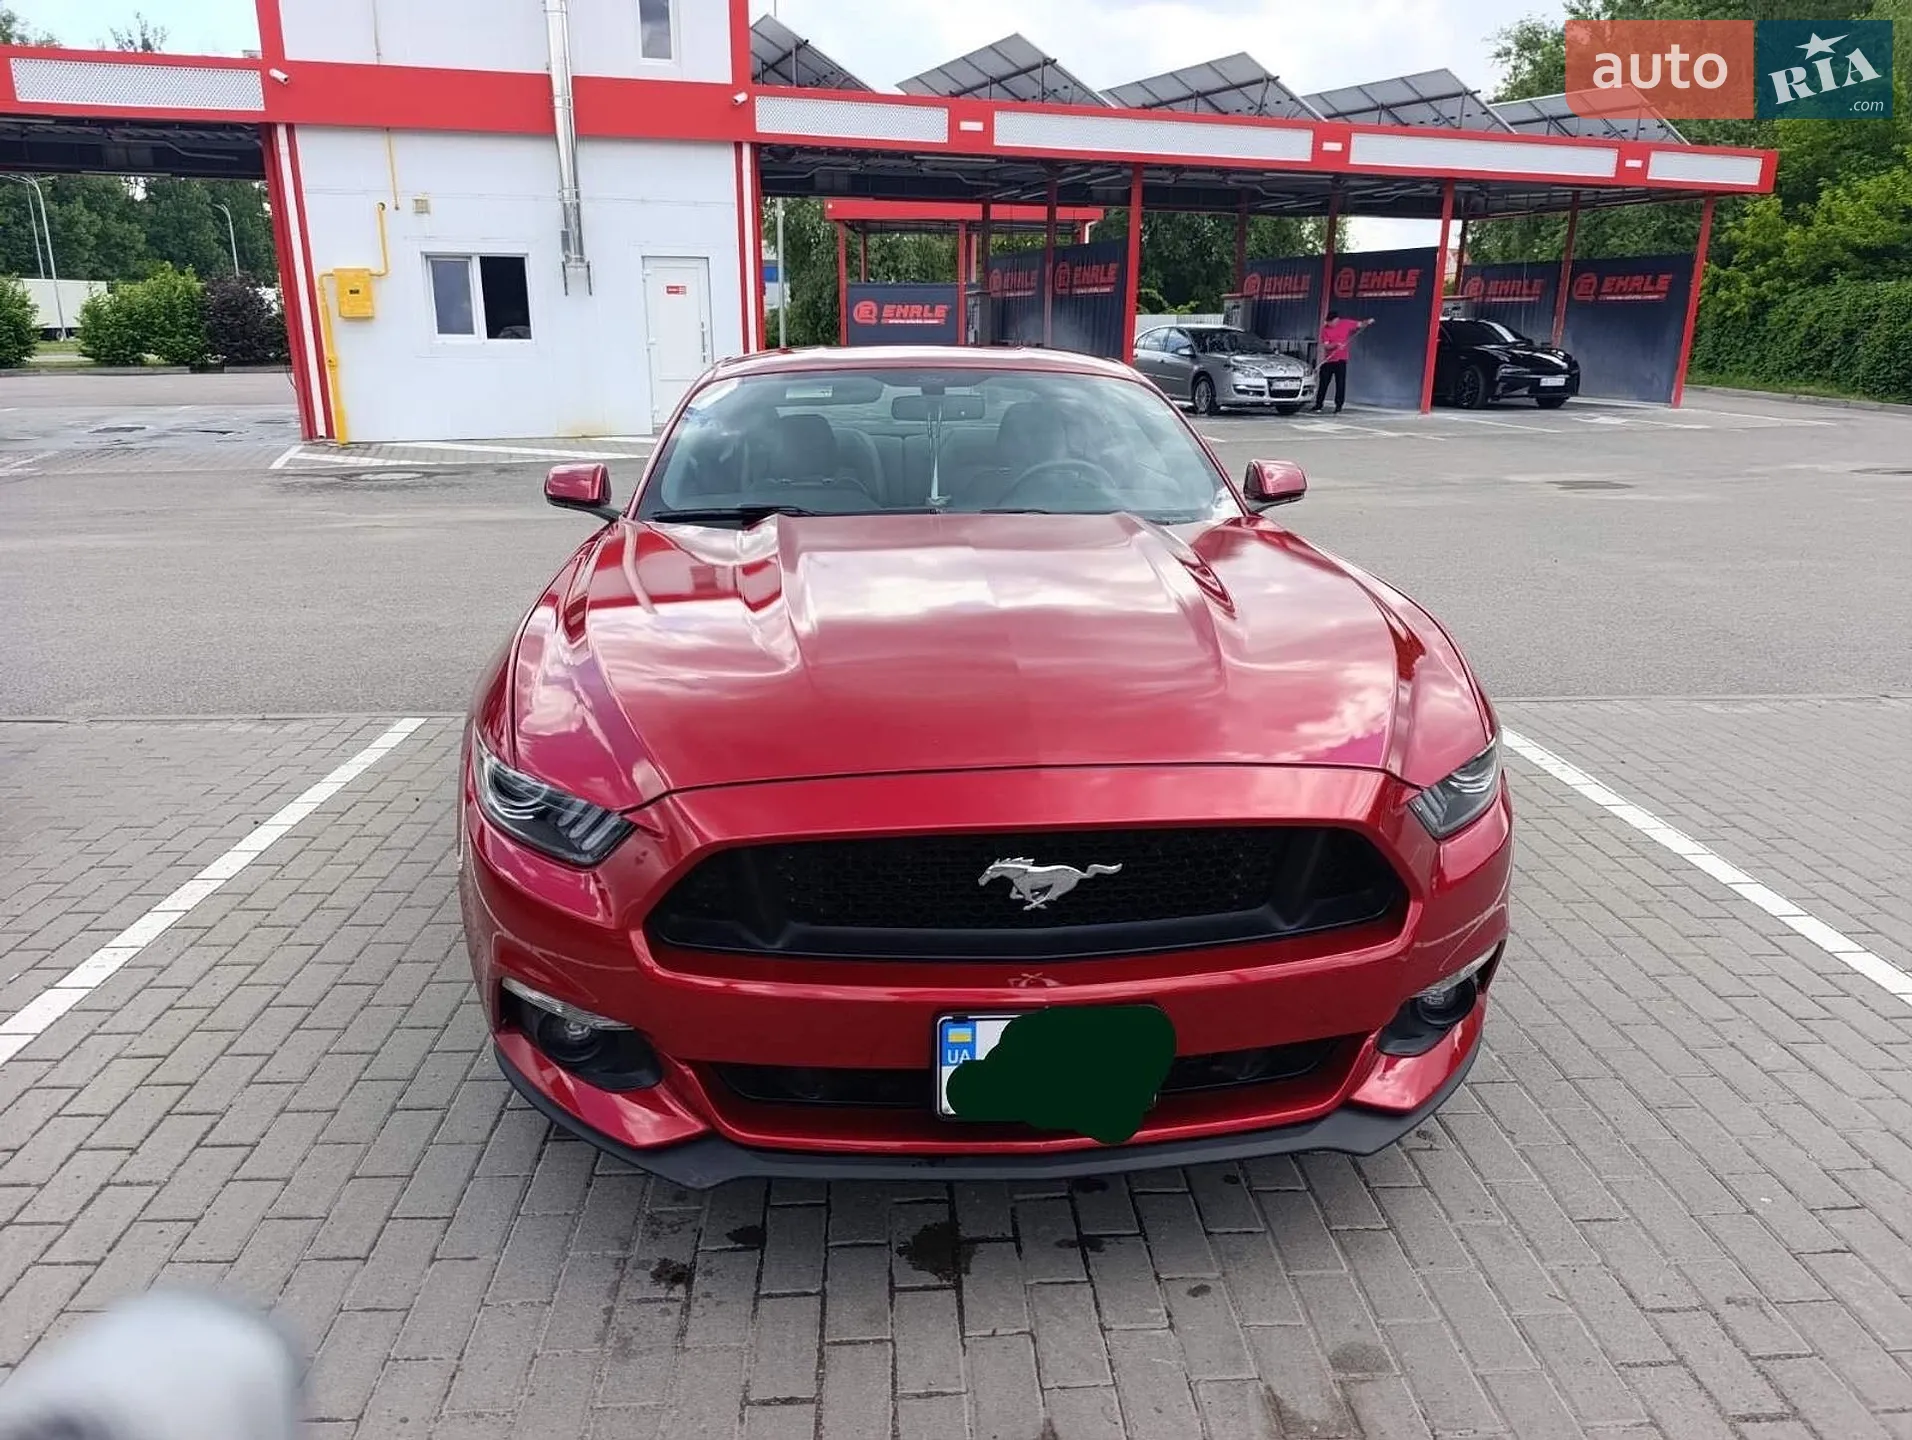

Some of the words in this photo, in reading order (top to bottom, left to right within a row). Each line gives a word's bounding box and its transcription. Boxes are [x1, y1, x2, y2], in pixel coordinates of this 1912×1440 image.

[1358, 269, 1421, 289] EHRLE
[1601, 274, 1672, 293] EHRLE
[883, 304, 948, 318] EHRLE
[947, 1049, 971, 1064] UA
